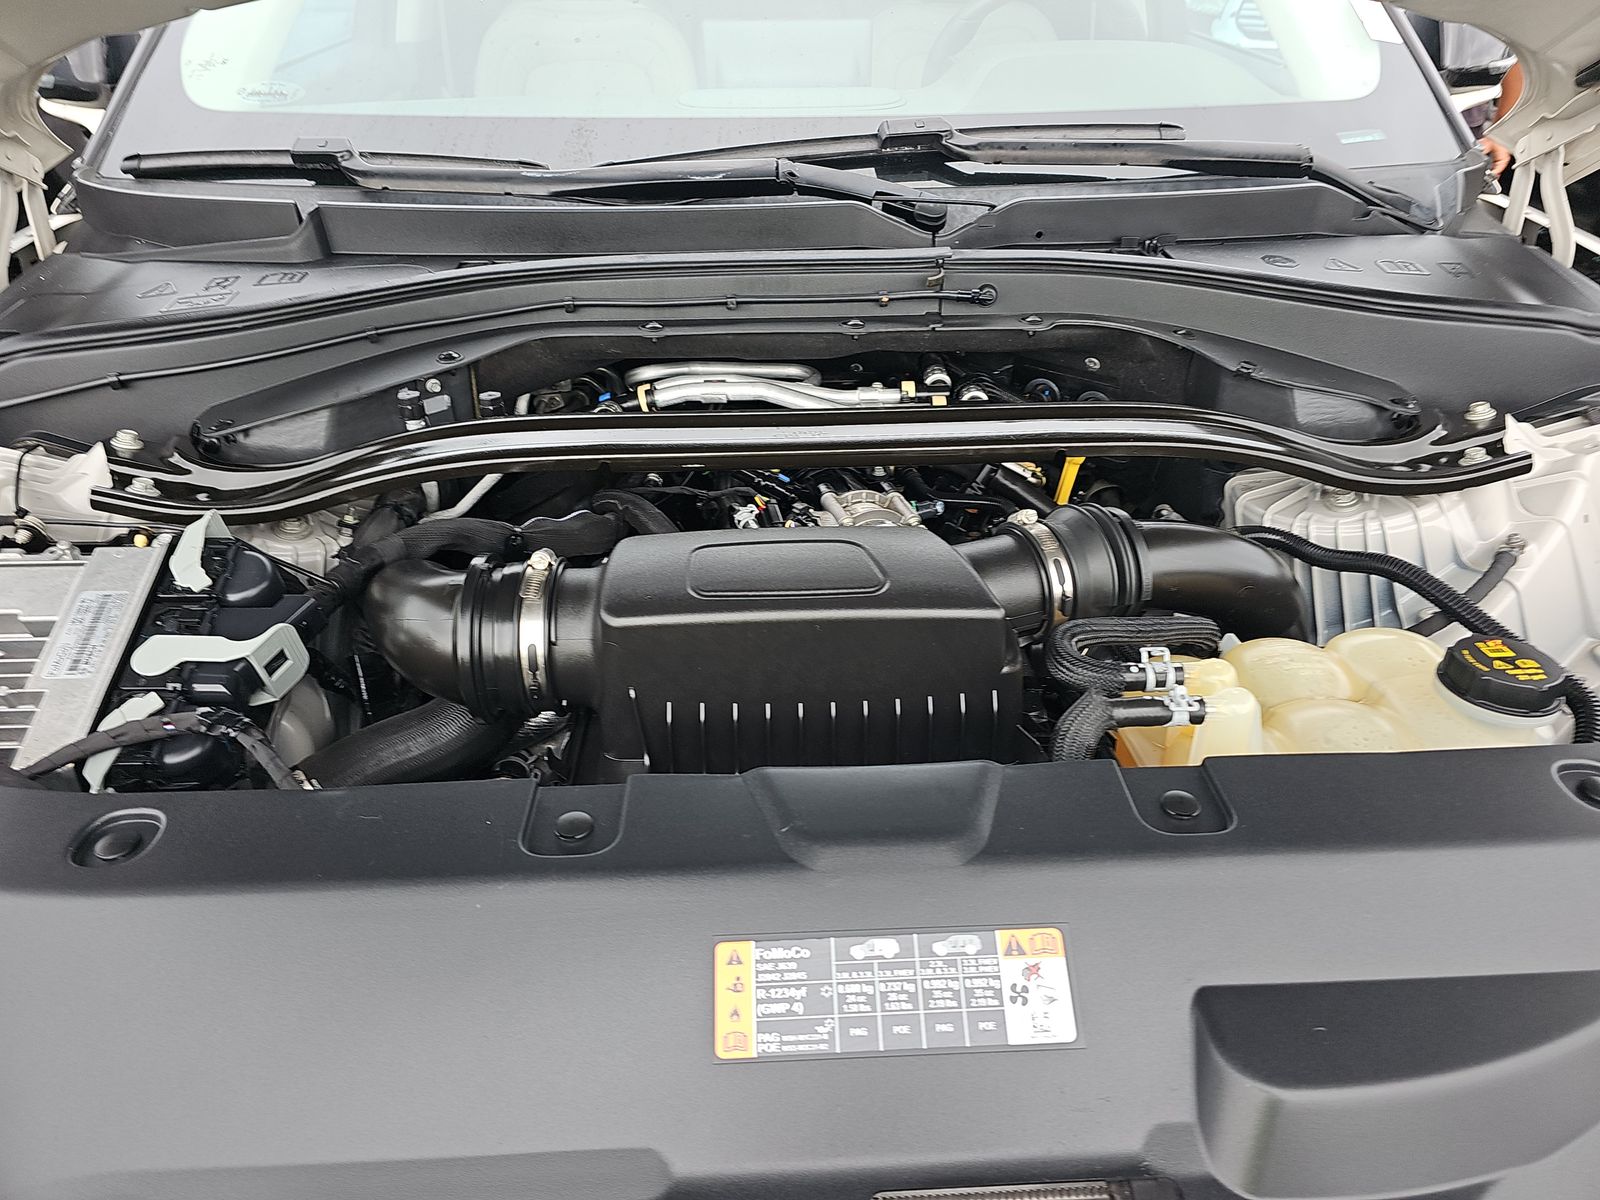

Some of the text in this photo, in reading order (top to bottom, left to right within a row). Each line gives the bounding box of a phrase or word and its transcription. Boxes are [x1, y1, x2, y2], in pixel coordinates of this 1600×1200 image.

[756, 947, 810, 960] FoMoCo
[756, 986, 808, 999] R-1234yf
[892, 1025, 912, 1034] POE
[935, 1023, 955, 1032] PAG
[978, 1022, 998, 1030] POE
[849, 1027, 869, 1036] PAG
[757, 1032, 780, 1042] PAG
[758, 1043, 781, 1052] POE
